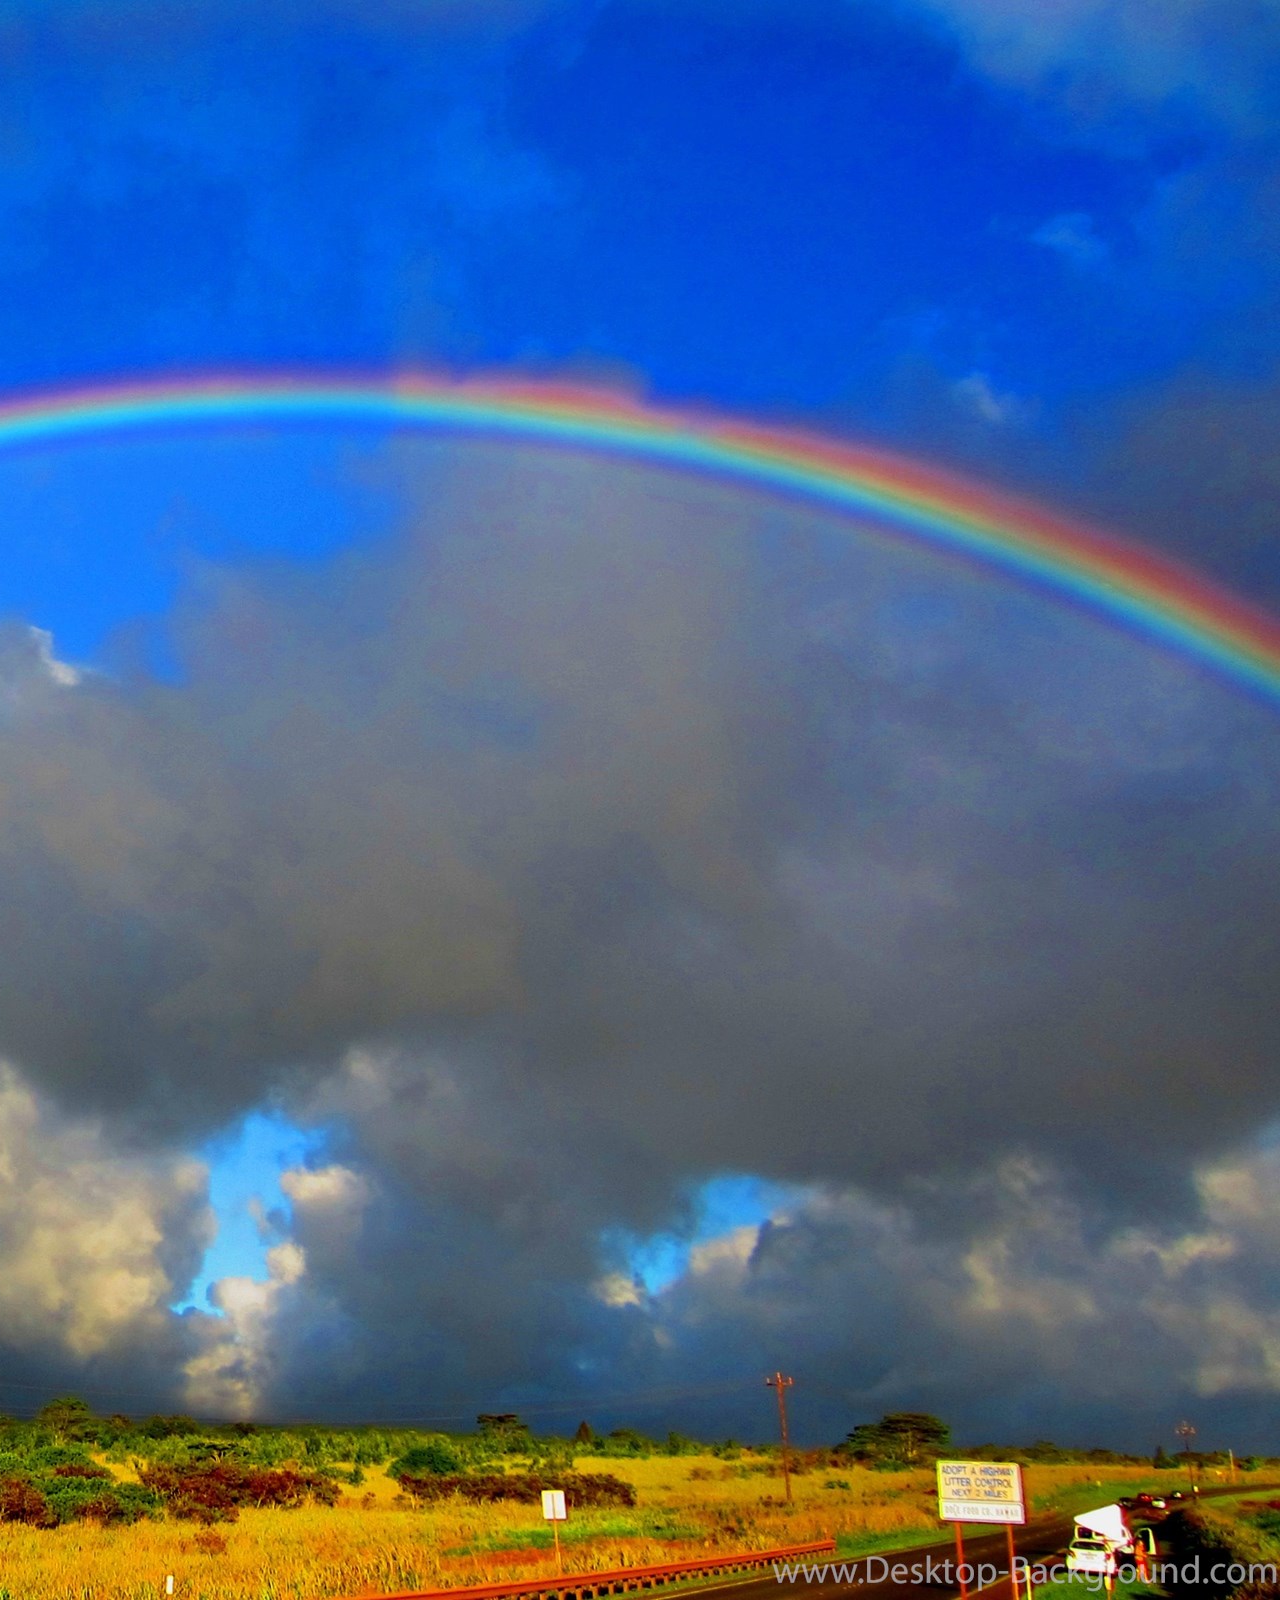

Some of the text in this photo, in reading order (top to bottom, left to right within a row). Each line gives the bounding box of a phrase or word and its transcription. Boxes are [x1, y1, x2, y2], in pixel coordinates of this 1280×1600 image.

[942, 1465, 967, 1475] ADOPT
[971, 1467, 977, 1475] A
[944, 1477, 1012, 1488] LITTER CONTROL
[952, 1488, 971, 1497] NEXT
[984, 1490, 1008, 1498] MILES
